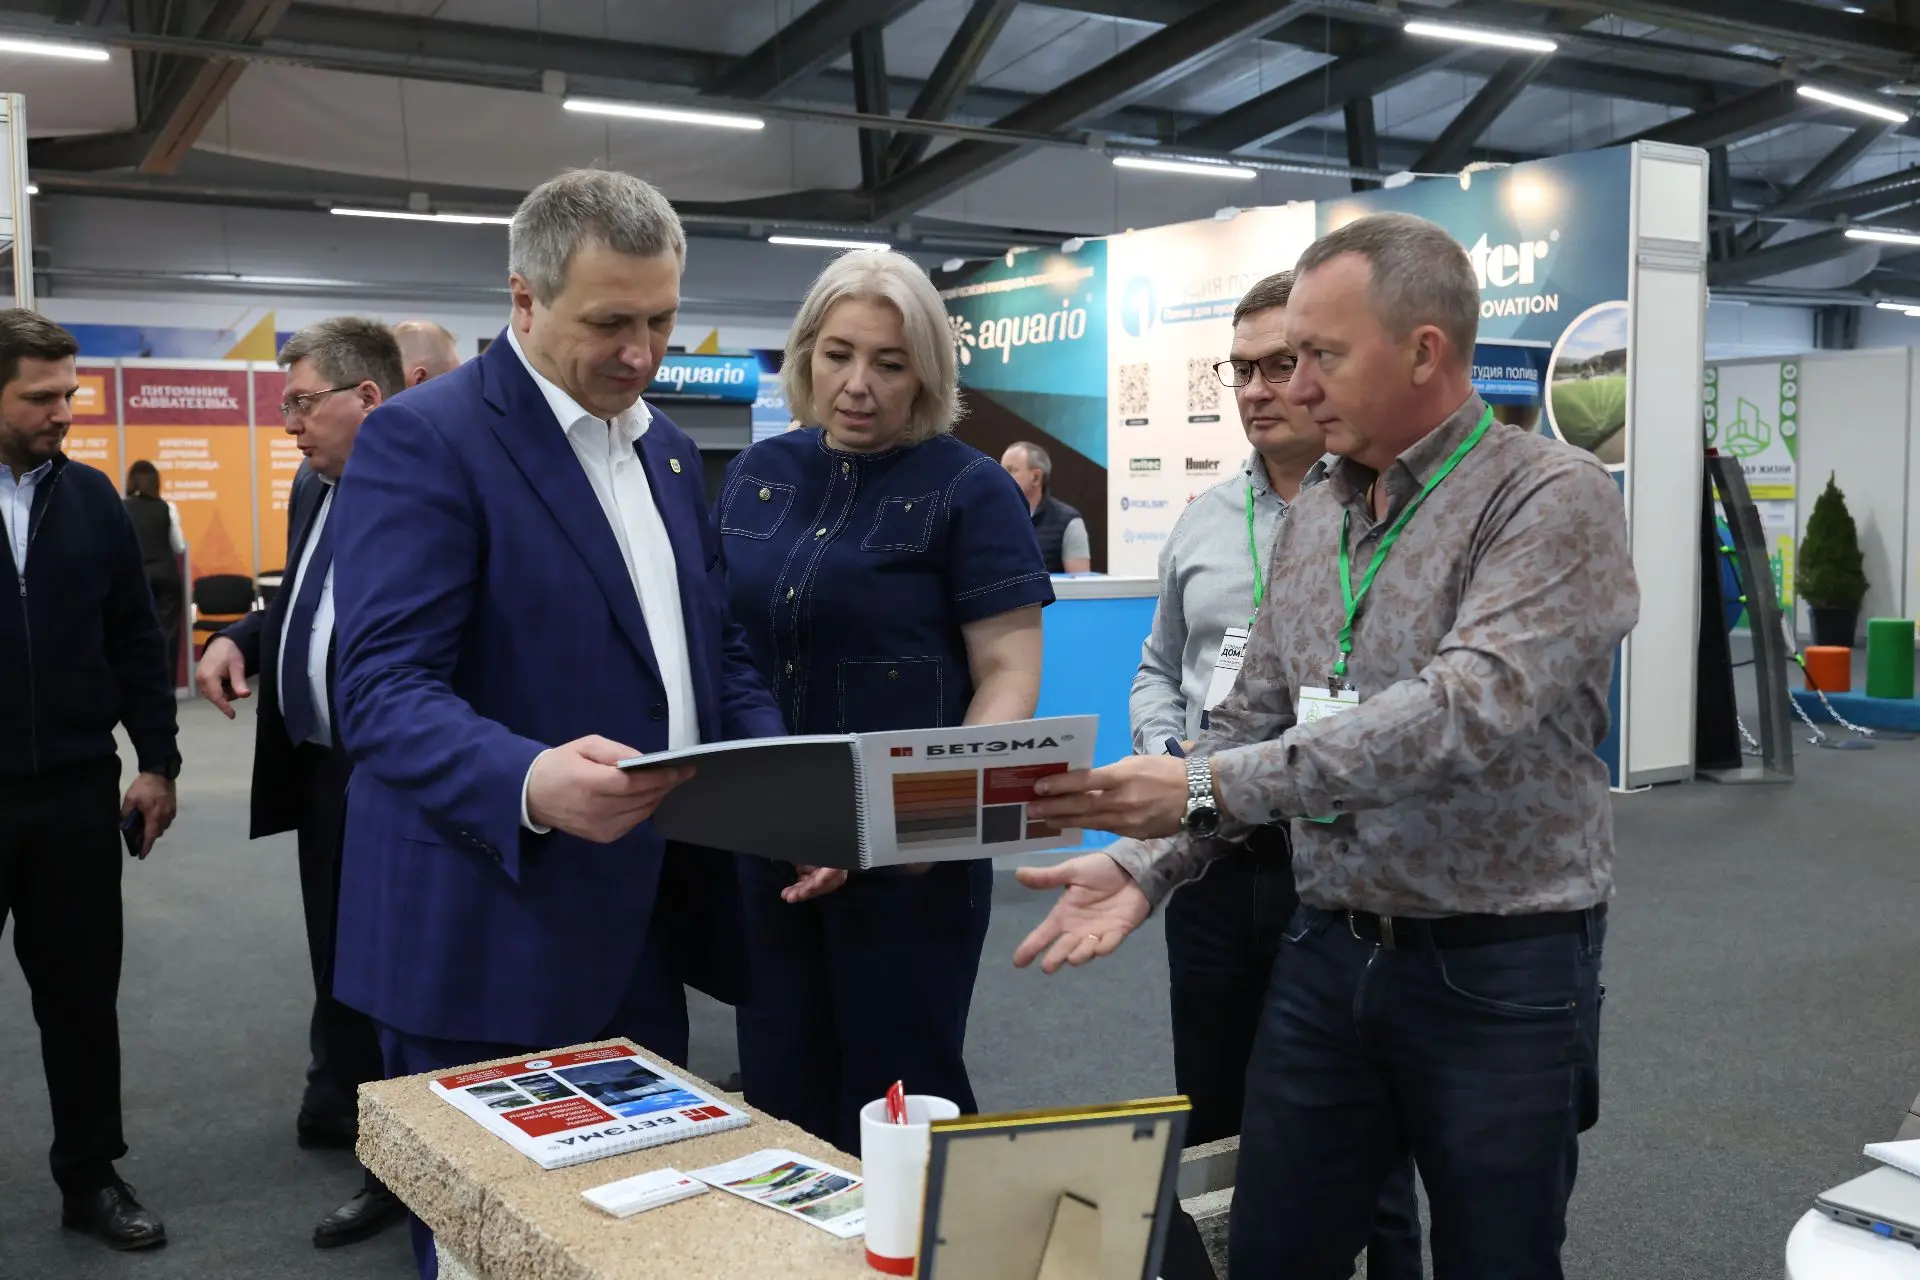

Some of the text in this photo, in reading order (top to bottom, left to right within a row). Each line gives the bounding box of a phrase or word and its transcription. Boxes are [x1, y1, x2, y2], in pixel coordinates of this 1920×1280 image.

[1467, 232, 1548, 290] ter
[1479, 293, 1559, 318] OVATION
[978, 298, 1087, 364] aquario
[654, 362, 745, 391] aquario
[1472, 365, 1503, 379] ТУДИЯ
[141, 385, 229, 397] ПИТОМНИК
[129, 395, 239, 410] САВВАТЕЕВЫХ
[1186, 457, 1220, 470] Hunter
[926, 737, 1059, 756] БЕТЭМА
[555, 1116, 677, 1146] БЕТЭМА
